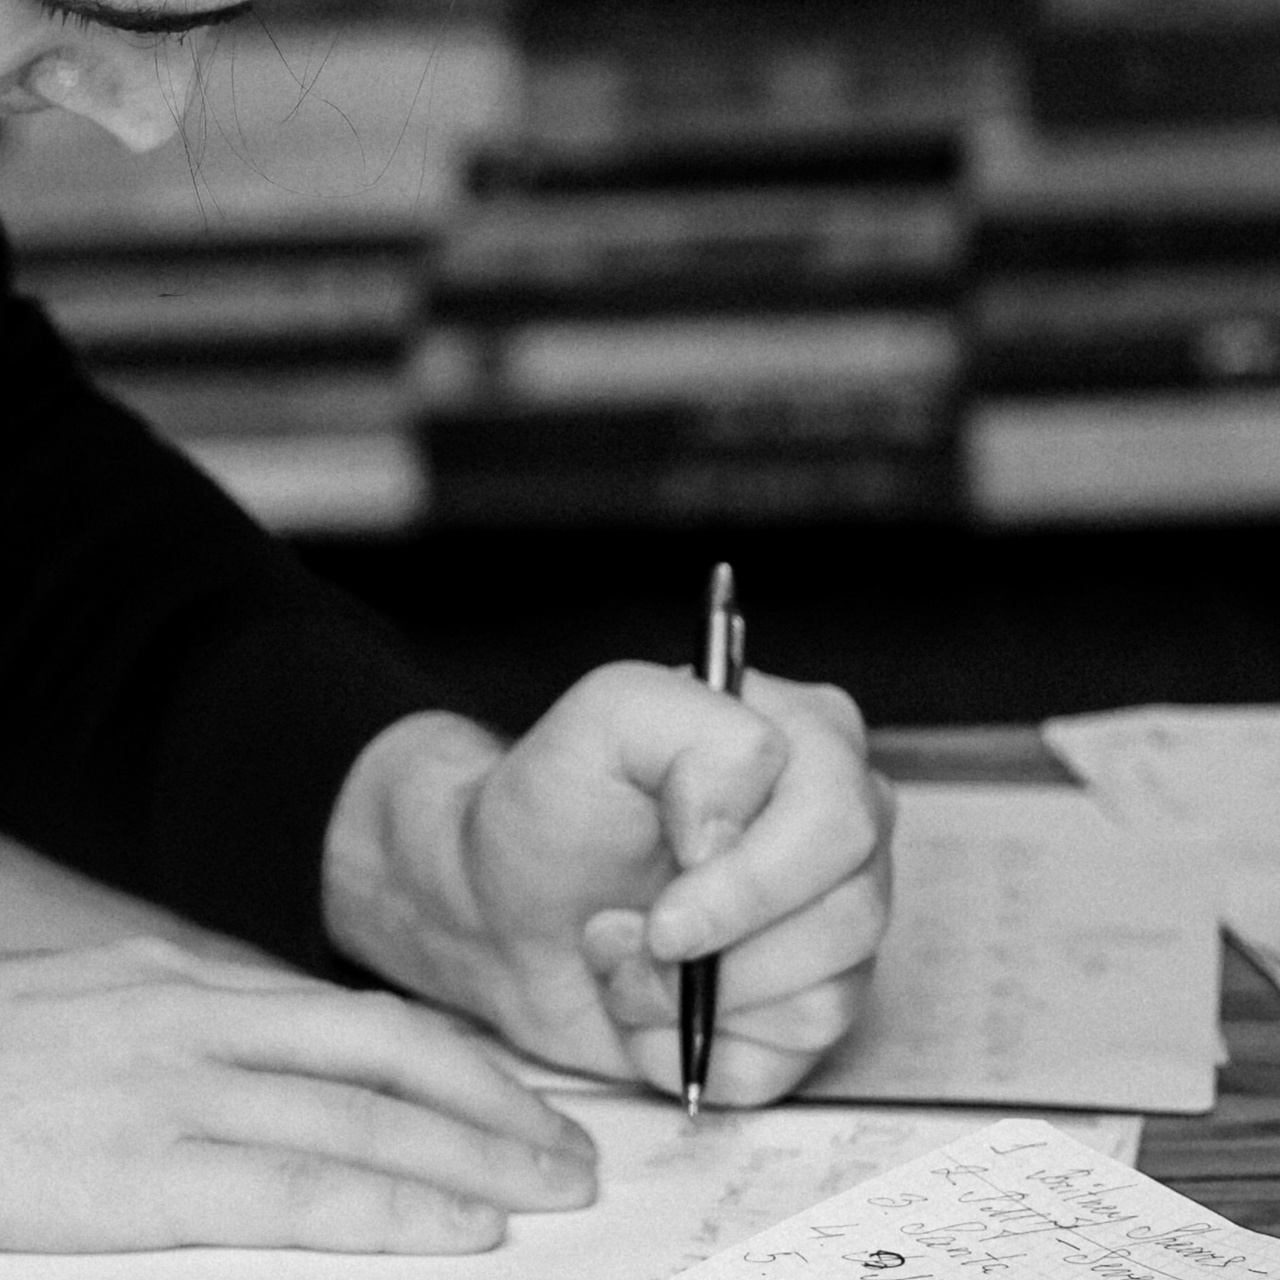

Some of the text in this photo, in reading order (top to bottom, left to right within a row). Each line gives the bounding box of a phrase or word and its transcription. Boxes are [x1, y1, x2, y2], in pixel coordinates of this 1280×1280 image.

[900, 1222, 1027, 1274] Santa
[1026, 1168, 1138, 1227] Britney
[1092, 1222, 1247, 1267] Spears
